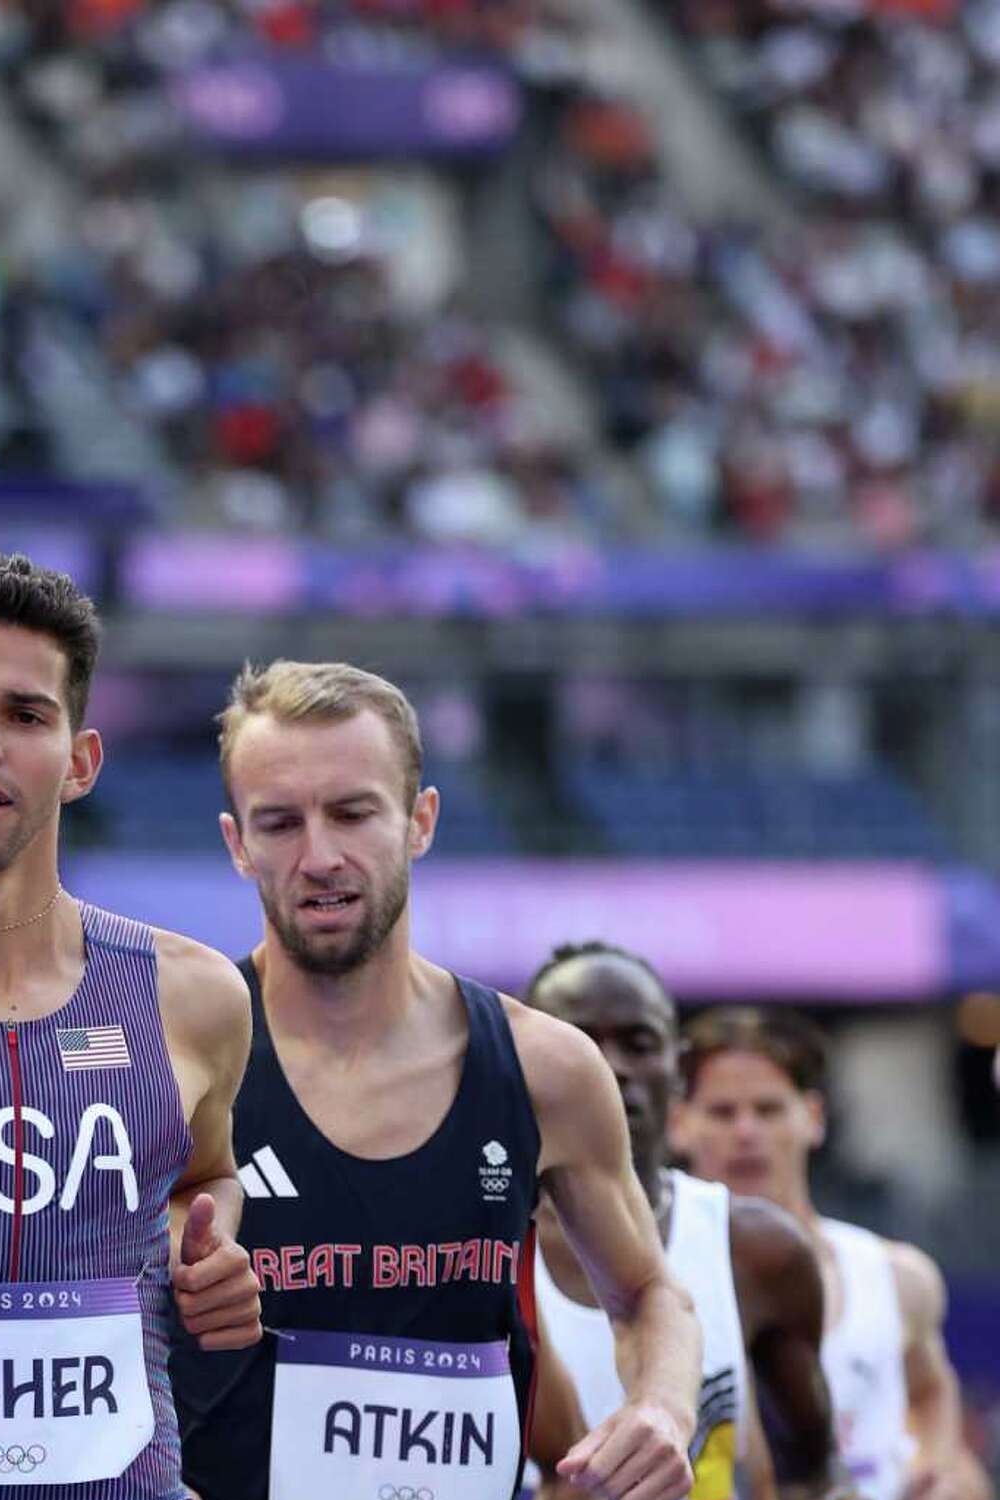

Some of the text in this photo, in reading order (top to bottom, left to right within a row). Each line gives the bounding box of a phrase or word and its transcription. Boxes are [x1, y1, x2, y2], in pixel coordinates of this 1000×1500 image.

[252, 1239, 519, 1291] REAT BRITAIN
[23, 1292, 81, 1309] 2024
[349, 1343, 481, 1370] PARIS 2024
[323, 1400, 495, 1466] ATKIN
